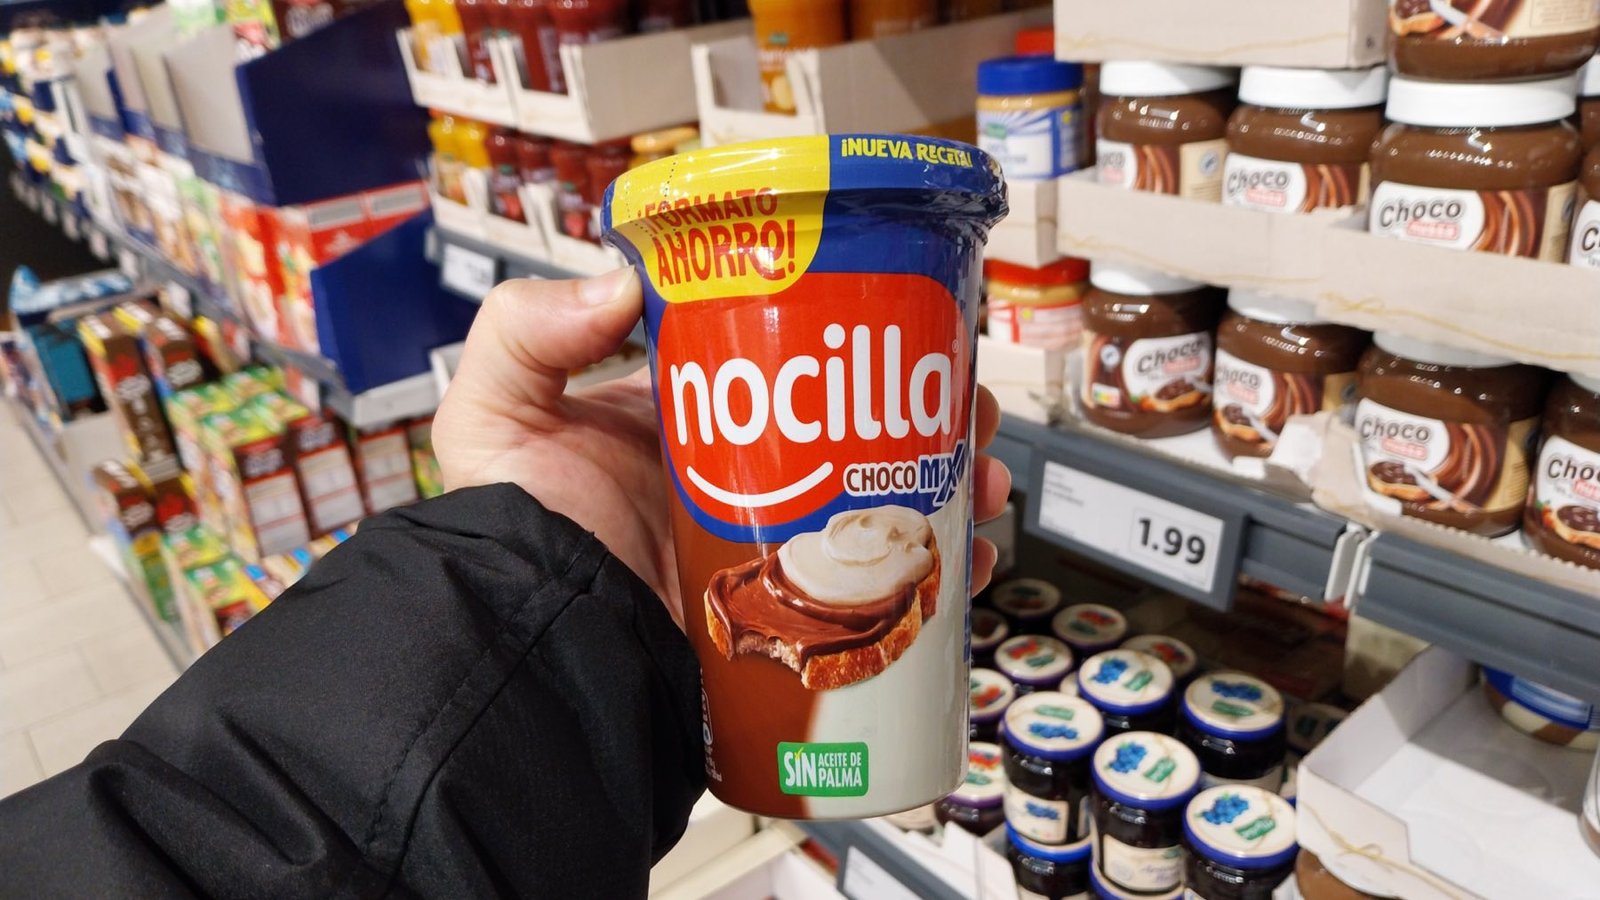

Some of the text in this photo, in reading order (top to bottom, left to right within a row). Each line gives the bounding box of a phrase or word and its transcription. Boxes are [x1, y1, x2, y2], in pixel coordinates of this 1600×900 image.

[1227, 169, 1290, 196] Choco
[1379, 199, 1463, 229] Choco
[651, 218, 796, 288] AHORRO!
[669, 322, 952, 446] nocilla
[1360, 415, 1431, 443] Choco
[1547, 458, 1600, 482] Cho
[1139, 517, 1206, 565] 1.99
[783, 749, 817, 788] SIN
[817, 751, 862, 768] ACEITE DE
[818, 767, 863, 788] PALMA
